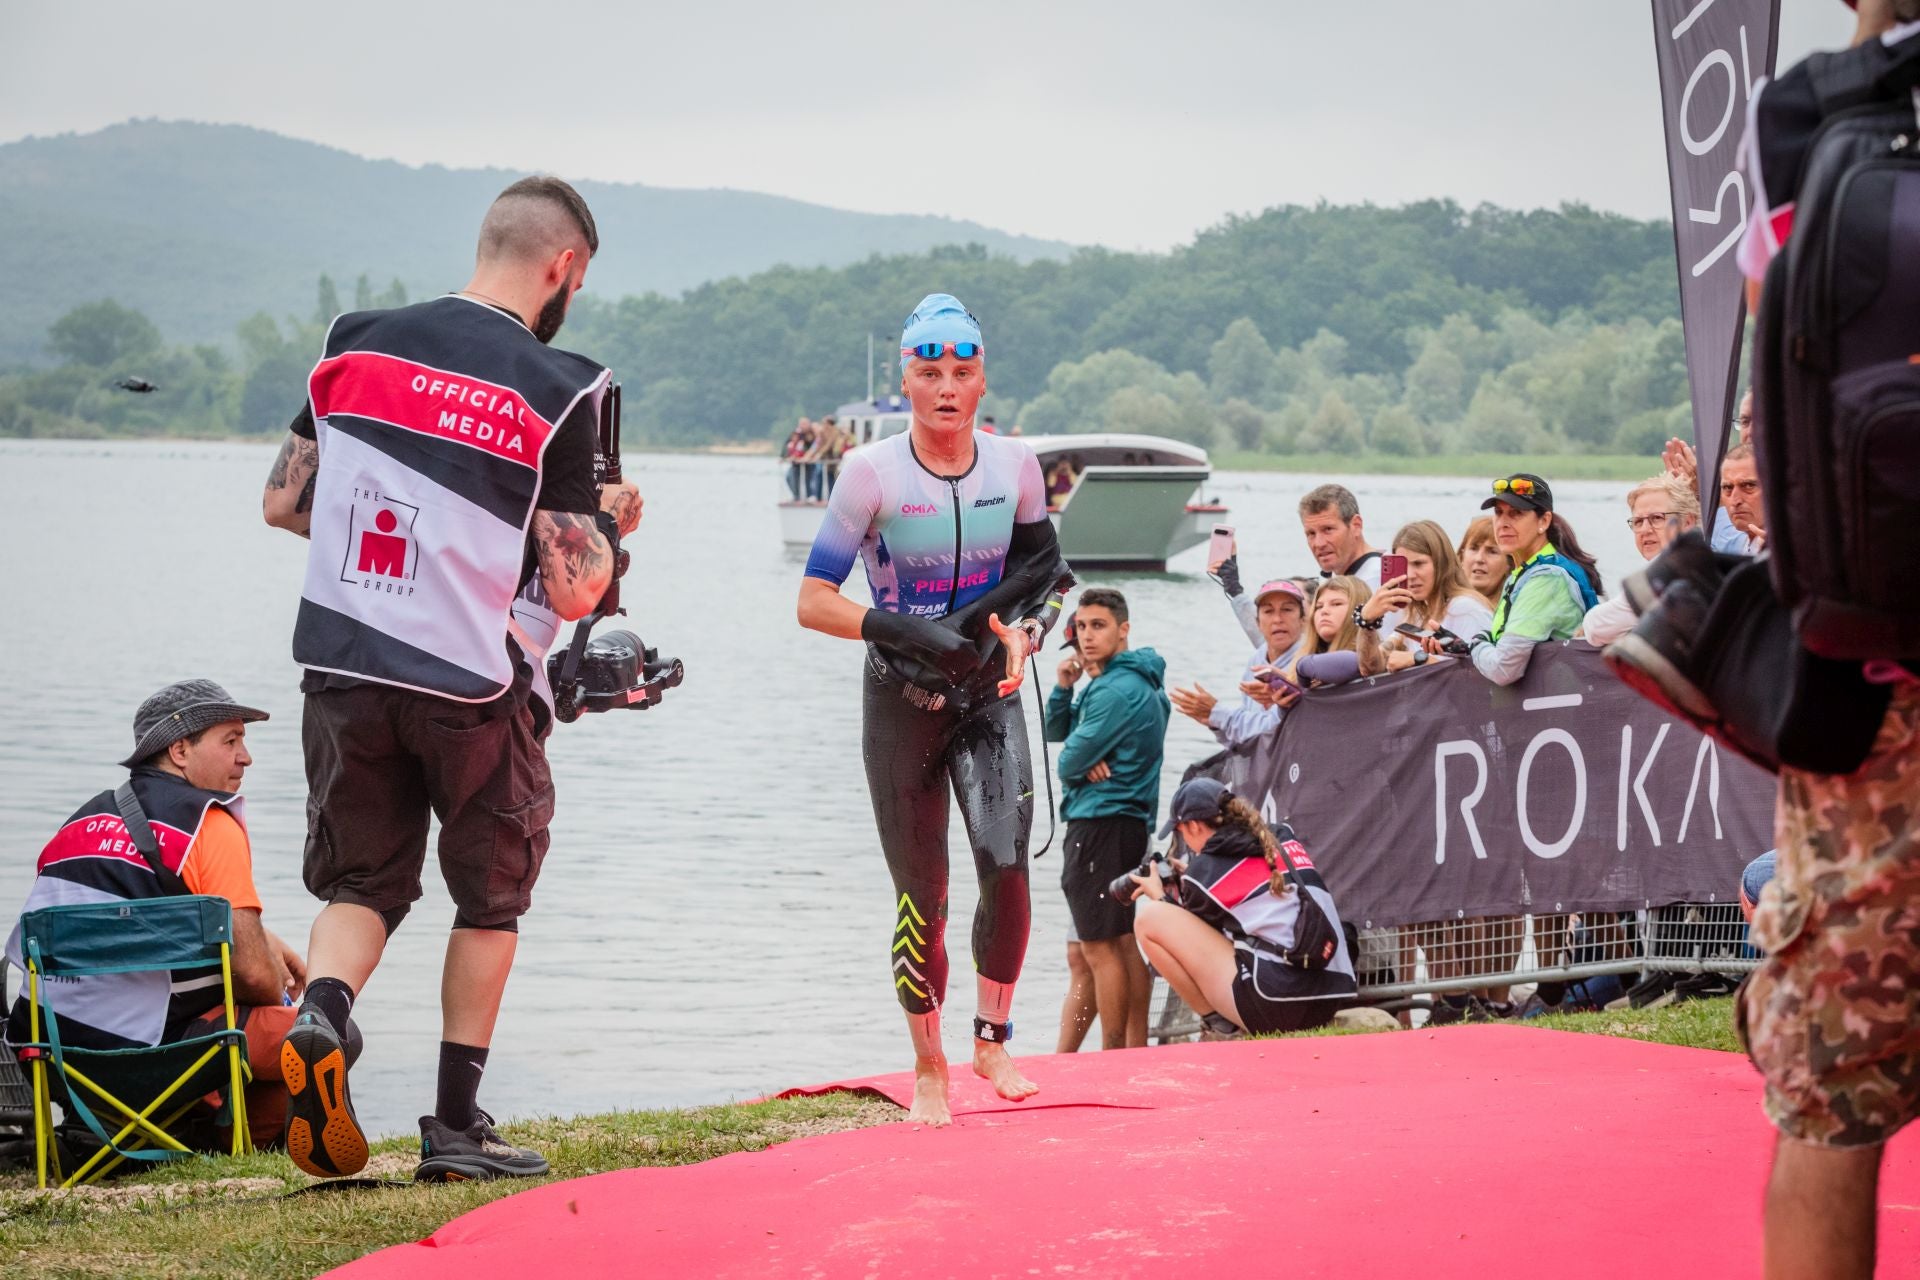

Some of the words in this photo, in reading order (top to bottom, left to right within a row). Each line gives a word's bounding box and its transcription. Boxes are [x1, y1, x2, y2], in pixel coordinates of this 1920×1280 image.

[411, 374, 527, 427] OFFICIAL
[438, 410, 523, 454] MEDIA
[354, 488, 379, 501] THE
[973, 495, 1006, 508] Santini
[905, 546, 1004, 567] CANYON
[364, 579, 414, 596] GROUP
[907, 602, 948, 615] TEAM
